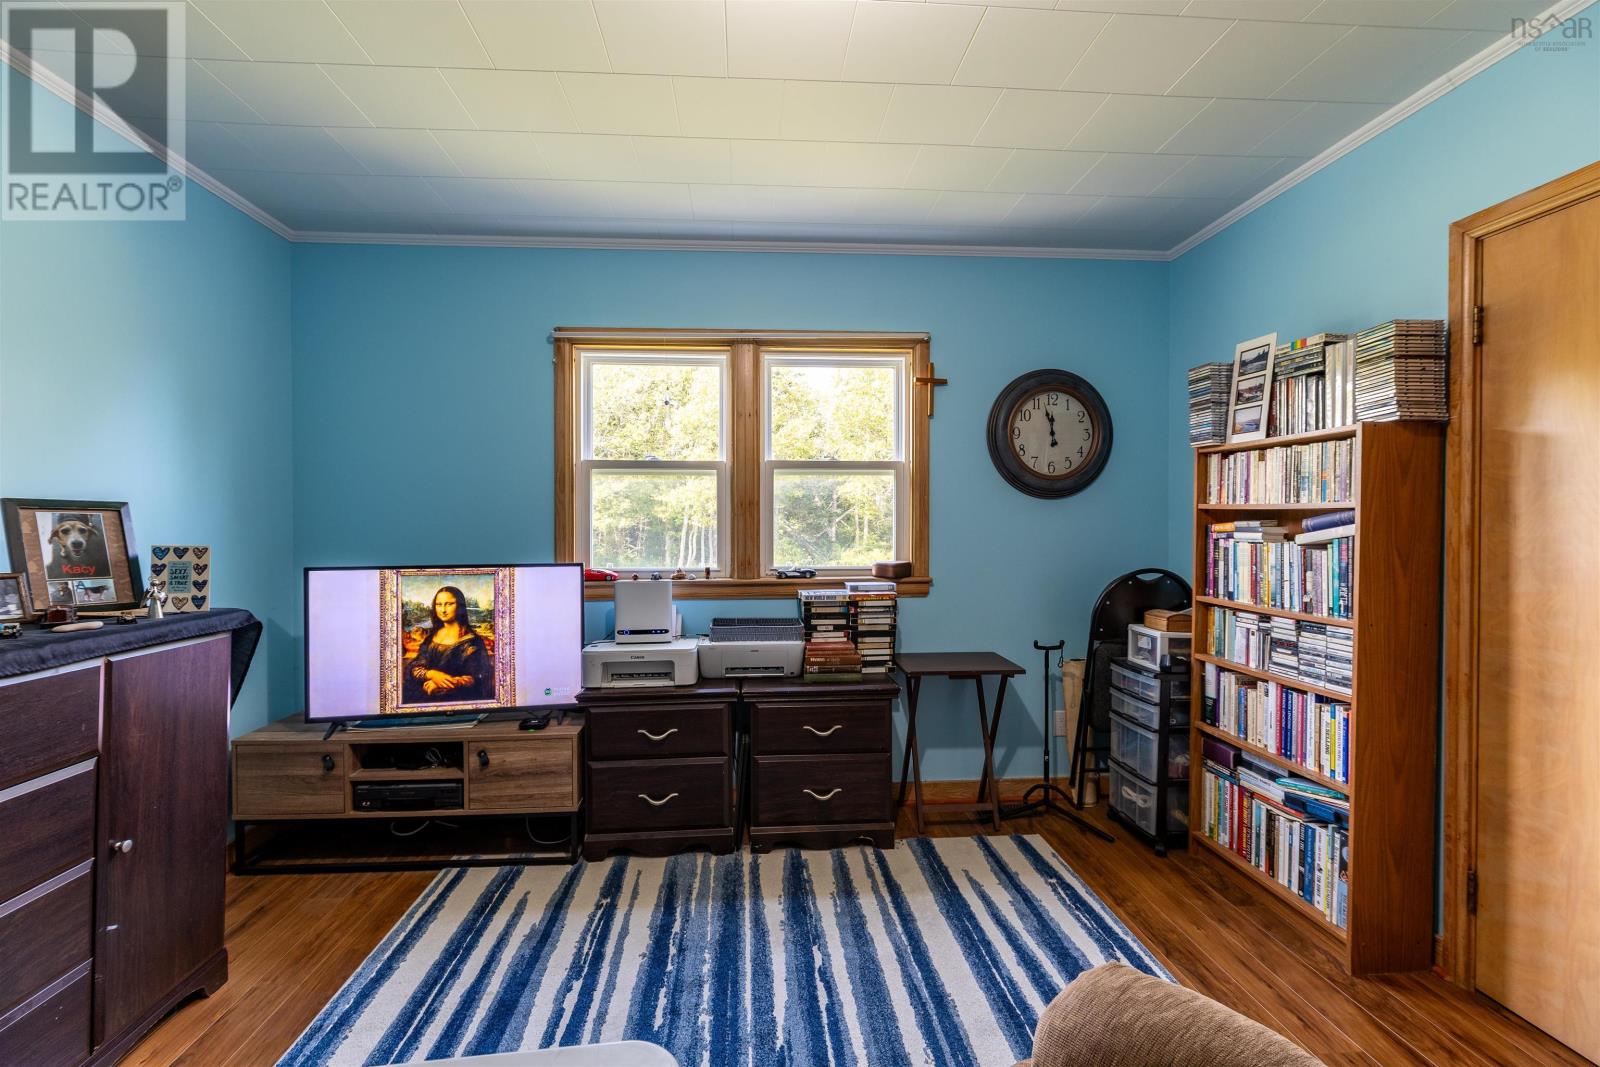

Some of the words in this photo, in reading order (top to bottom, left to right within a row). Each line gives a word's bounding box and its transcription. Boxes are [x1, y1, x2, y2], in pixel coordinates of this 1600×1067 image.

[1032, 397, 1041, 410] 11
[1046, 392, 1059, 406] 12
[1019, 409, 1032, 422] 10
[1077, 410, 1085, 423] 2
[1012, 427, 1021, 440] 9
[1083, 428, 1091, 441] 3
[1018, 444, 1026, 457] 8
[1076, 446, 1084, 458] 4
[1030, 456, 1039, 469] 7
[1047, 461, 1056, 474] 6
[1064, 457, 1072, 470] 5
[62, 564, 96, 576] Kacy
